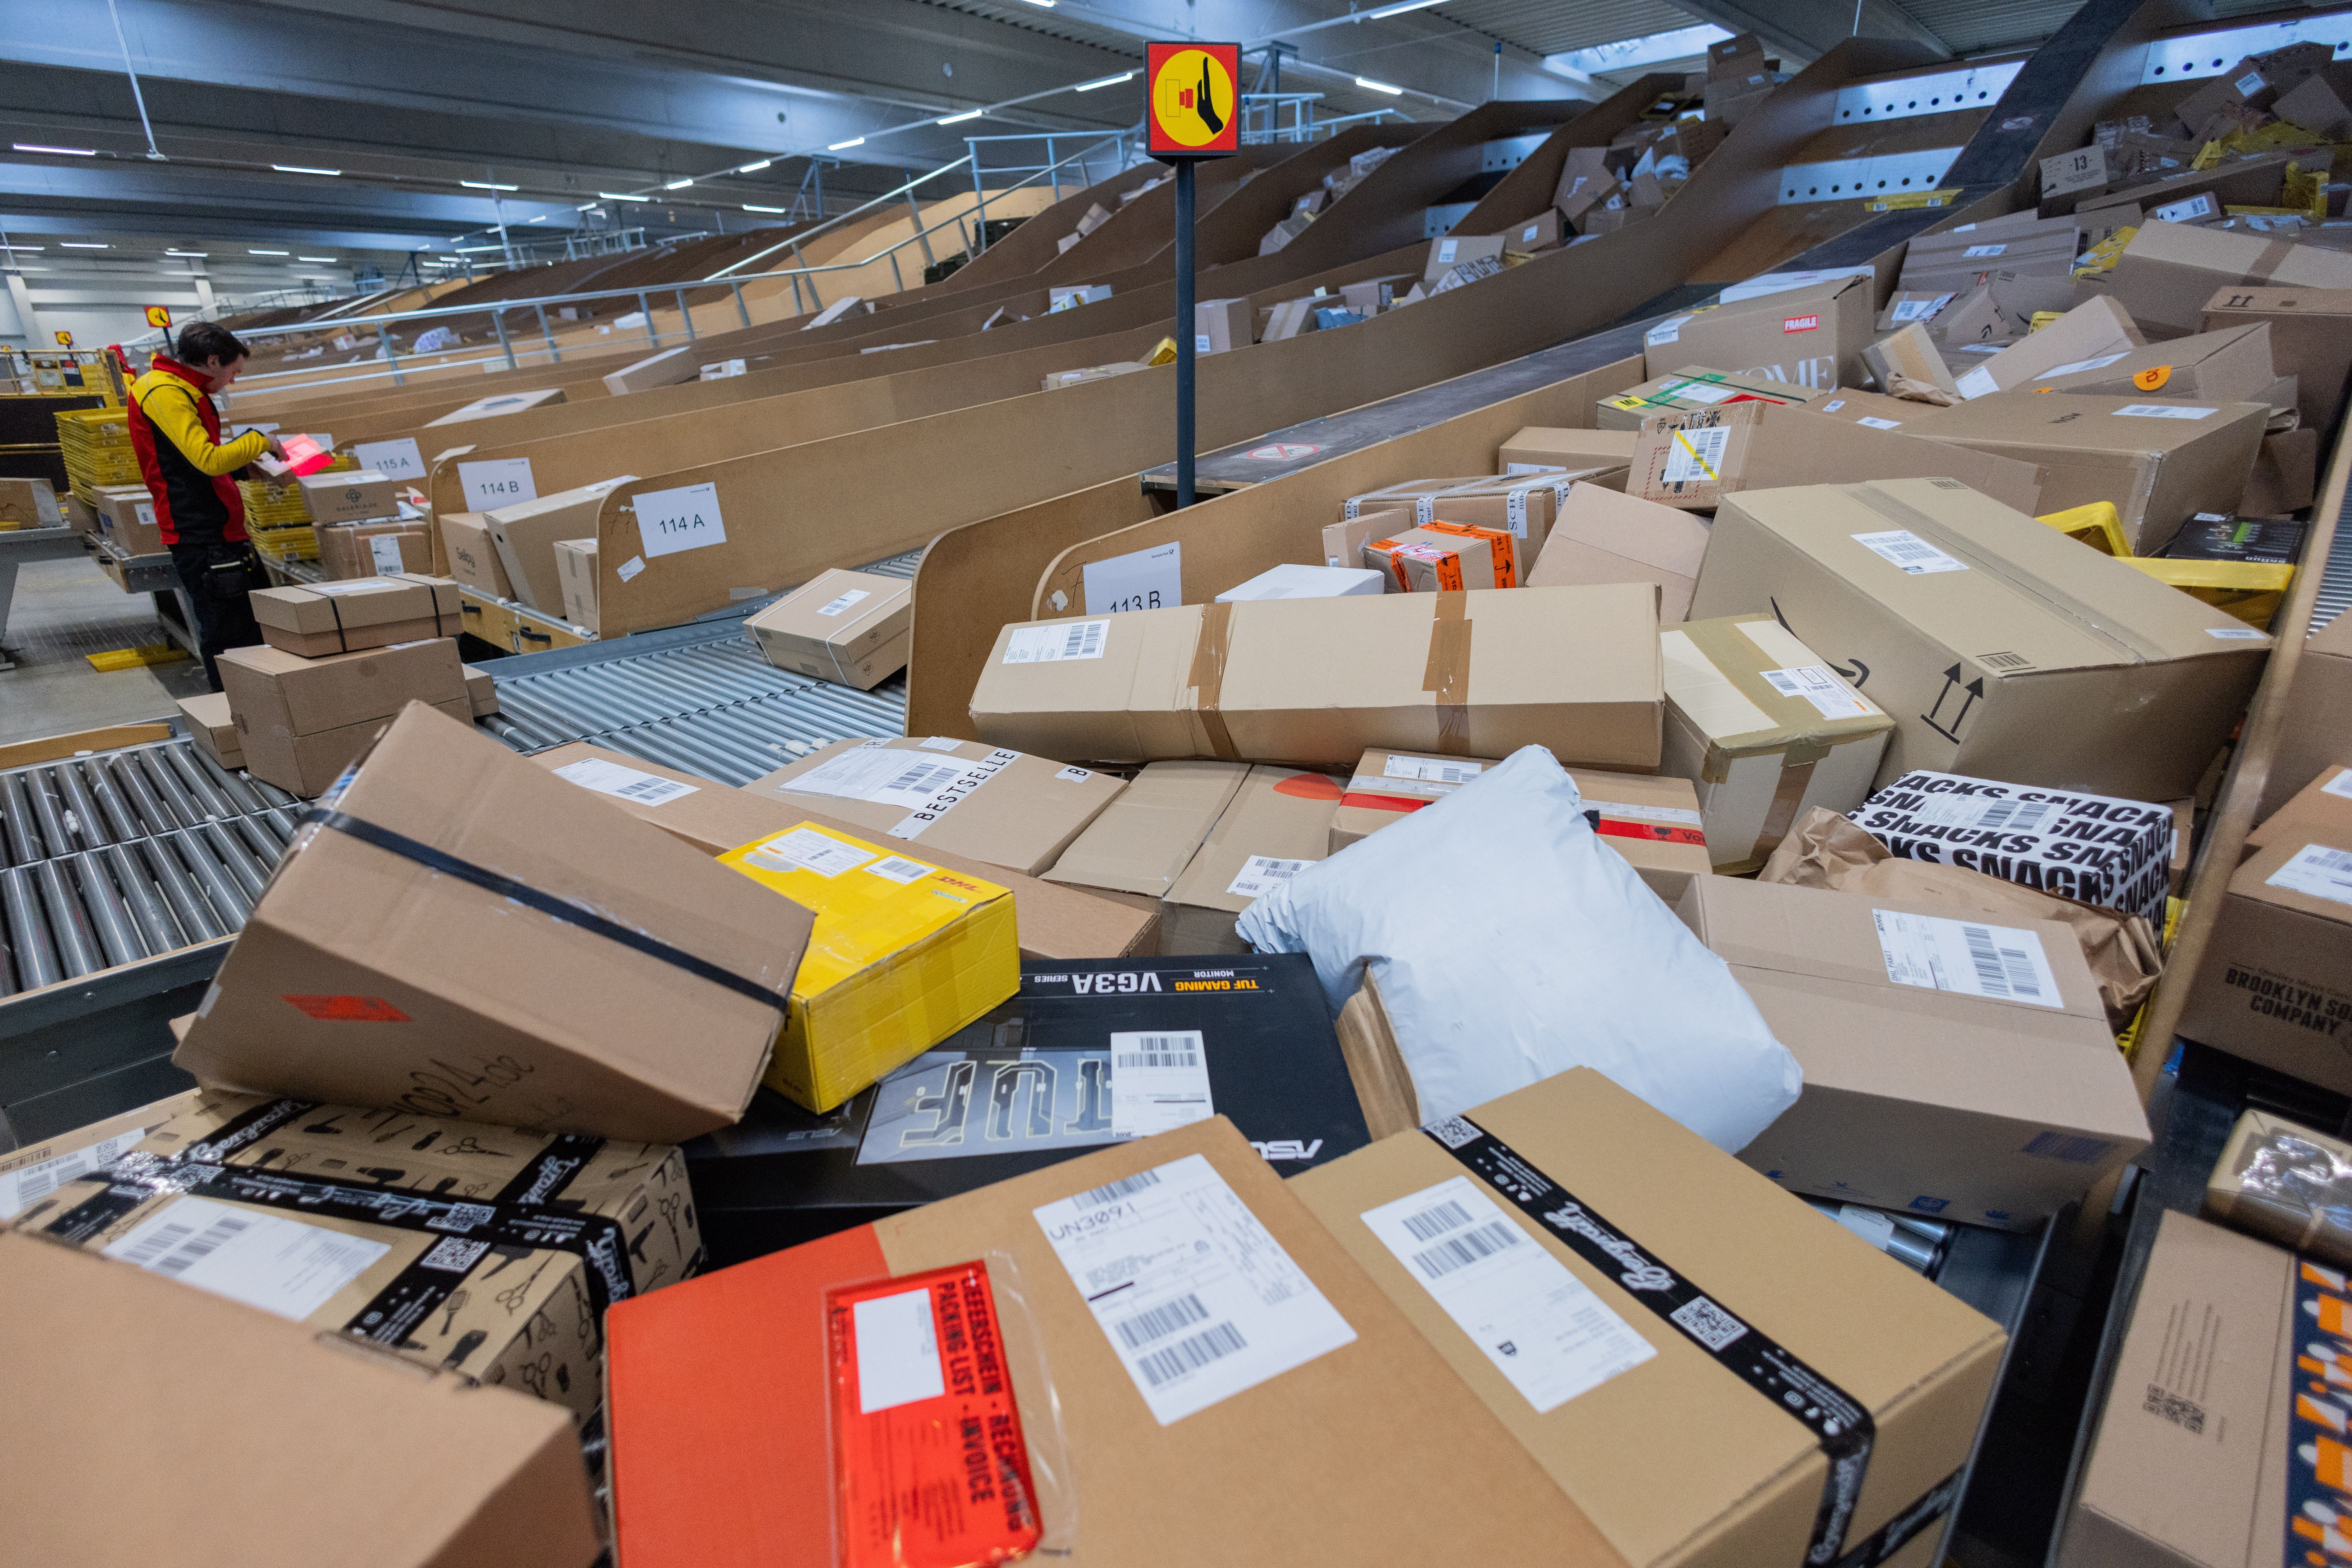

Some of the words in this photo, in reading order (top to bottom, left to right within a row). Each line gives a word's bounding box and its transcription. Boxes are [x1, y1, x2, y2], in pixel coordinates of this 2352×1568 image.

[1785, 316, 1817, 331] FRAGILE
[376, 459, 398, 471] 115
[400, 457, 410, 467] A
[480, 482, 505, 495] 114
[509, 481, 519, 493] B
[660, 516, 688, 533] 114
[694, 514, 705, 528] A
[1110, 595, 1142, 612] 113
[1149, 590, 1161, 609] B
[1864, 811, 2039, 853] SNACKS
[1883, 949, 1895, 968] PAKET
[1034, 974, 1068, 983] SERIES
[1071, 972, 1162, 994] VG3A
[1193, 970, 1234, 978] MONITOR
[1890, 969, 1898, 981] DHL
[1174, 980, 1230, 992] GAMING
[1233, 979, 1259, 990] TUF
[2225, 968, 2323, 1011] BROOKLYN
[2250, 996, 2342, 1034] COMPANY
[936, 1281, 968, 1353] PACKING
[949, 1355, 976, 1396] LIST
[960, 1415, 995, 1505] INVOICE
